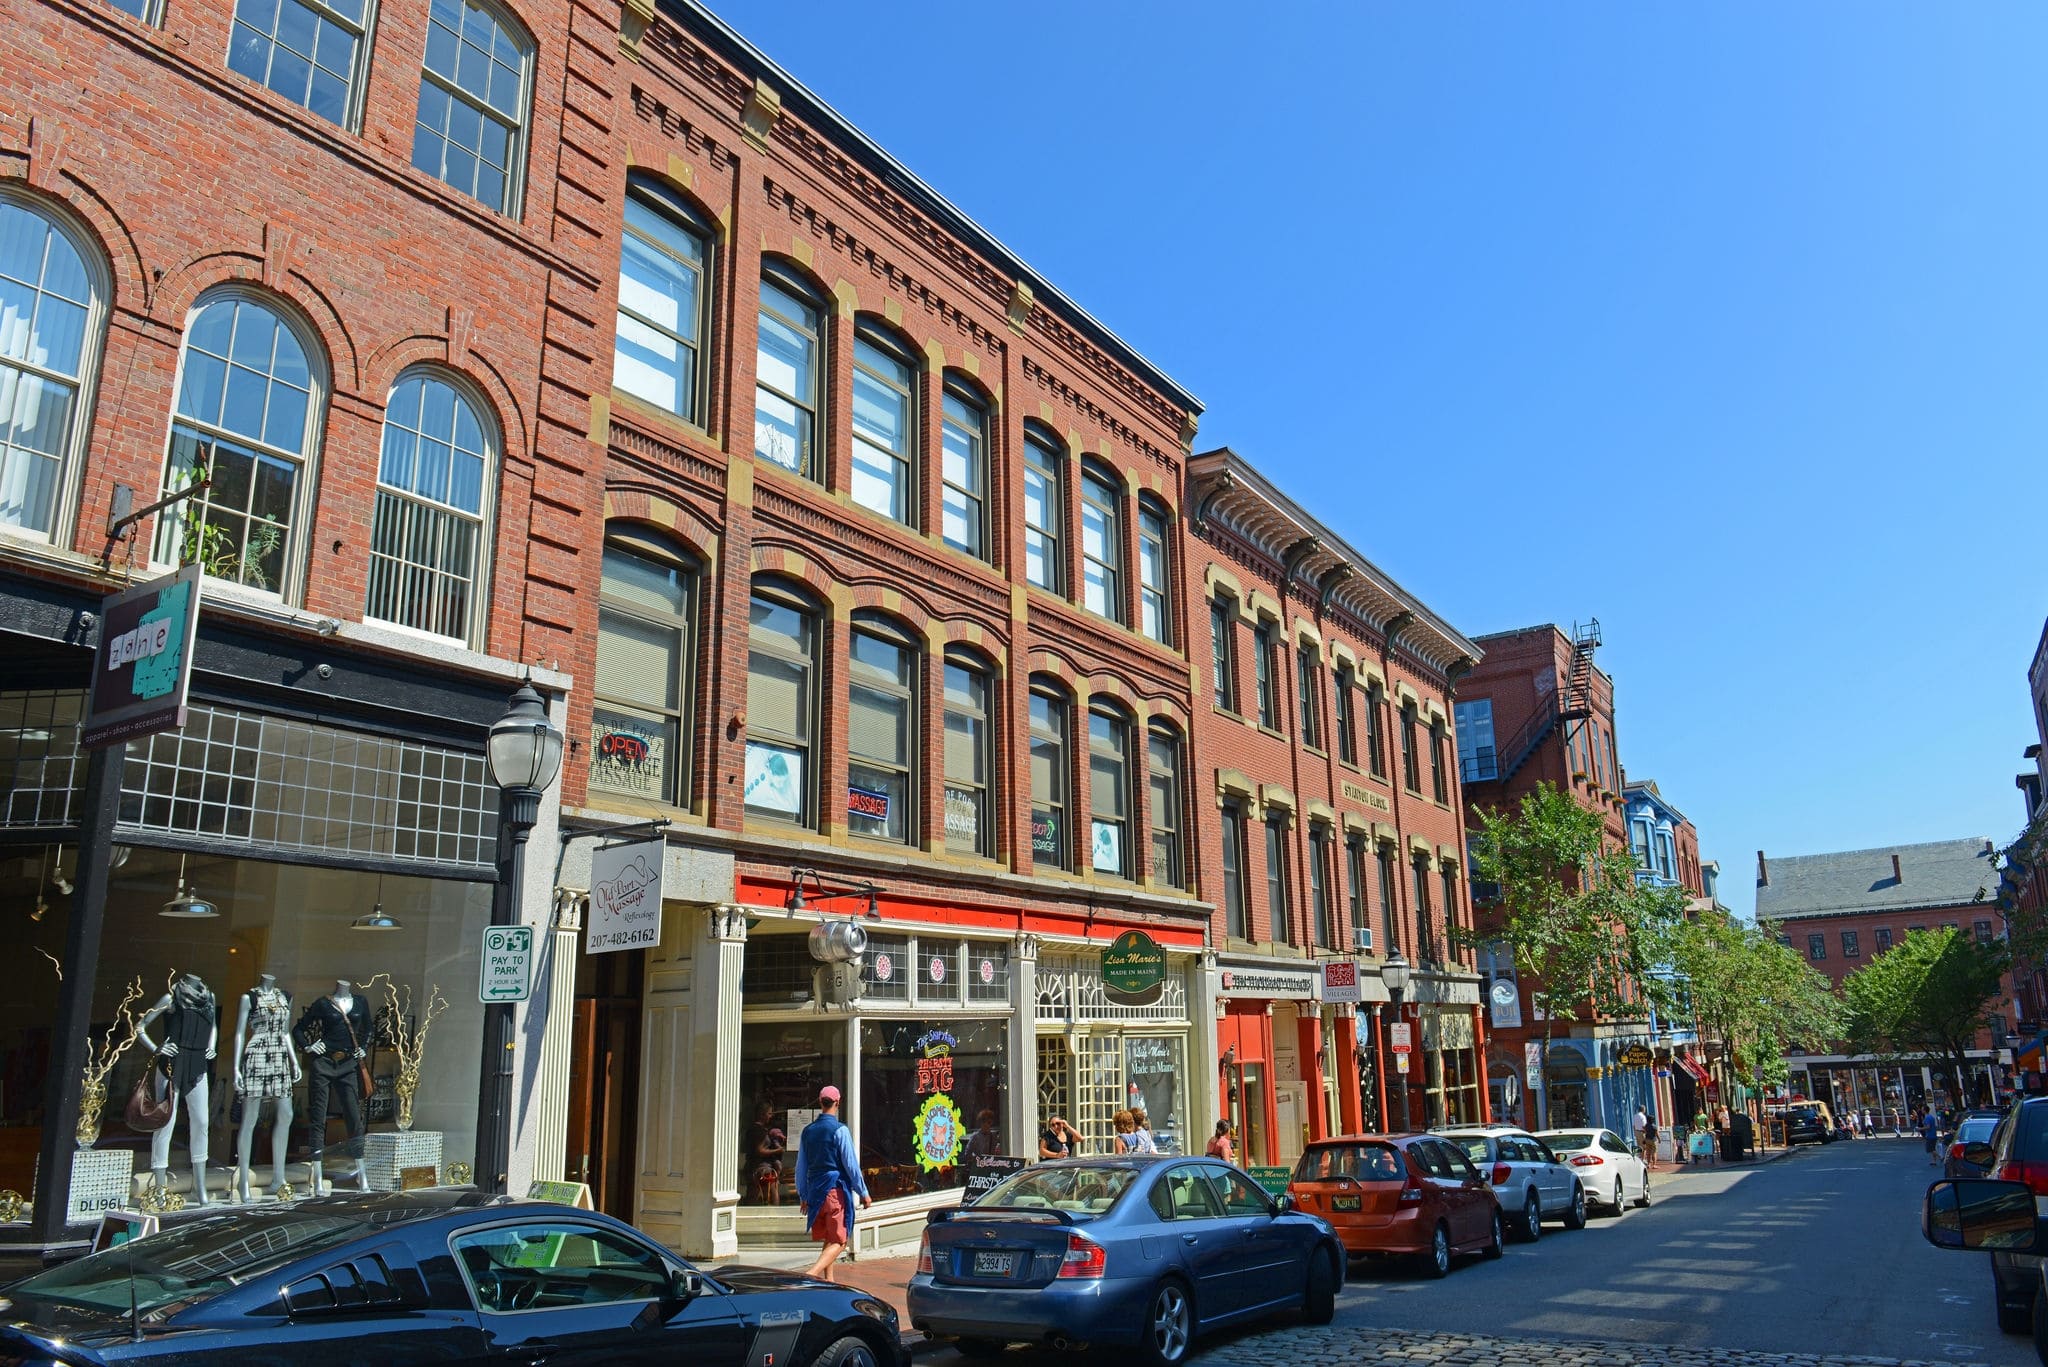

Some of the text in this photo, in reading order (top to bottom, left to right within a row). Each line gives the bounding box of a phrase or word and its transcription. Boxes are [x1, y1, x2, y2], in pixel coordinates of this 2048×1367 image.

[112, 628, 166, 662] zane
[85, 713, 172, 743] apparel shoes accessories
[602, 733, 648, 762] OPEN
[944, 813, 977, 834] ASSAGE
[1031, 822, 1047, 836] OOT
[615, 880, 635, 896] Port
[608, 889, 645, 915] Massage
[591, 928, 654, 948] 207-482-6162
[491, 956, 524, 965] PAY TO
[495, 967, 518, 975] PARK
[1326, 990, 1357, 998] VILLAGES
[1131, 1061, 1149, 1074] Made
[1156, 1060, 1175, 1073] Maine
[916, 1067, 954, 1093] PIG
[925, 1141, 945, 1160] BEER
[976, 1156, 1011, 1168] Welcome
[980, 1257, 1011, 1270] 2994 TS
